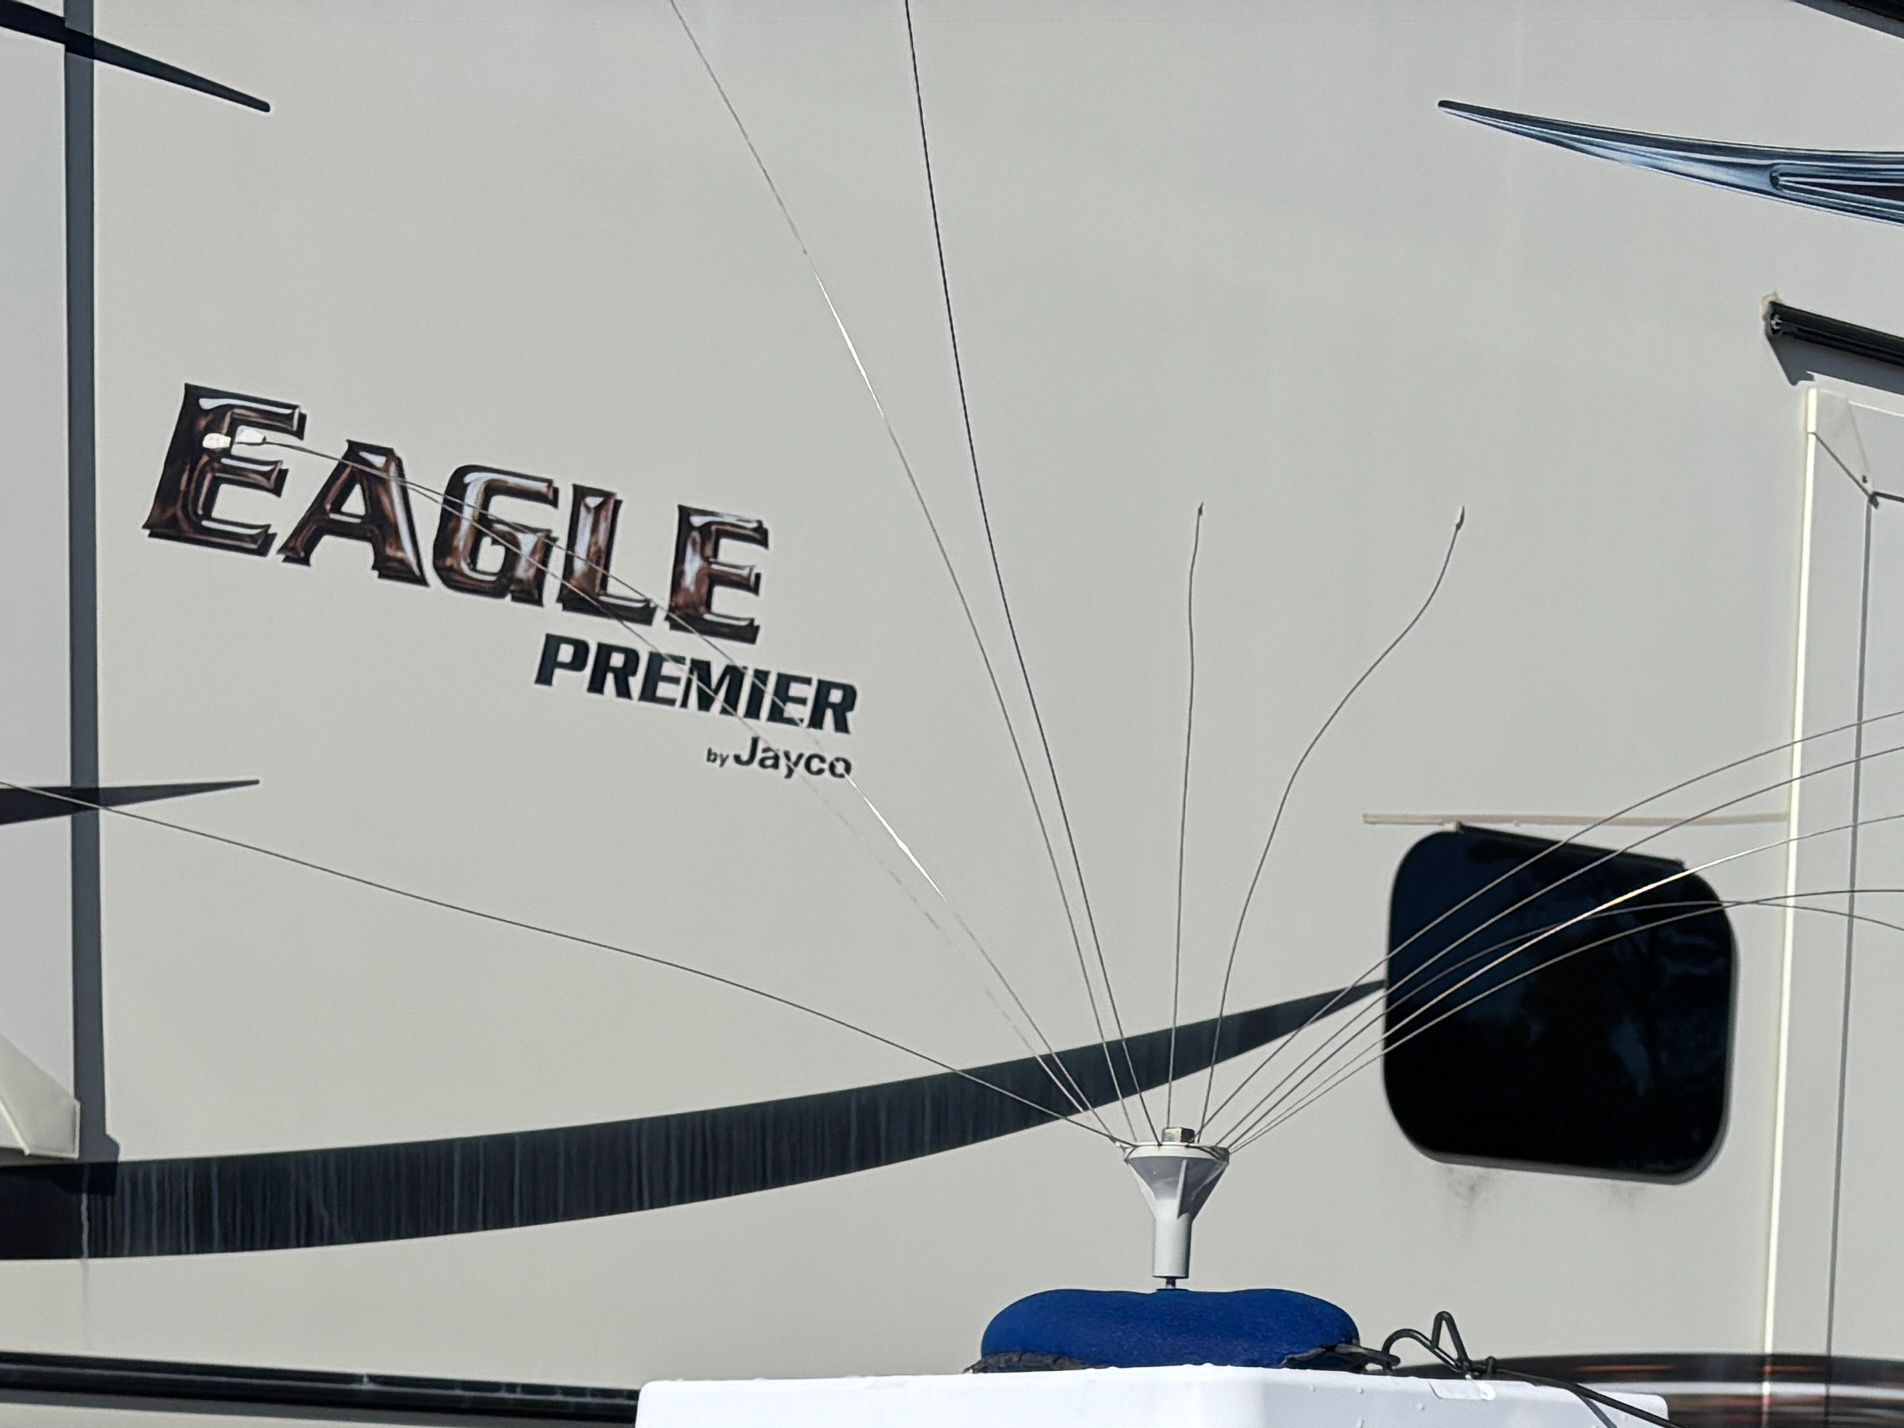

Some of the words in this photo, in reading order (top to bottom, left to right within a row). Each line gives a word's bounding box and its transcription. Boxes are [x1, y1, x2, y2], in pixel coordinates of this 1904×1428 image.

[142, 382, 769, 644] EAGLE
[533, 632, 858, 734] PREMIER
[705, 745, 730, 769] by
[732, 735, 852, 780] Jayco
